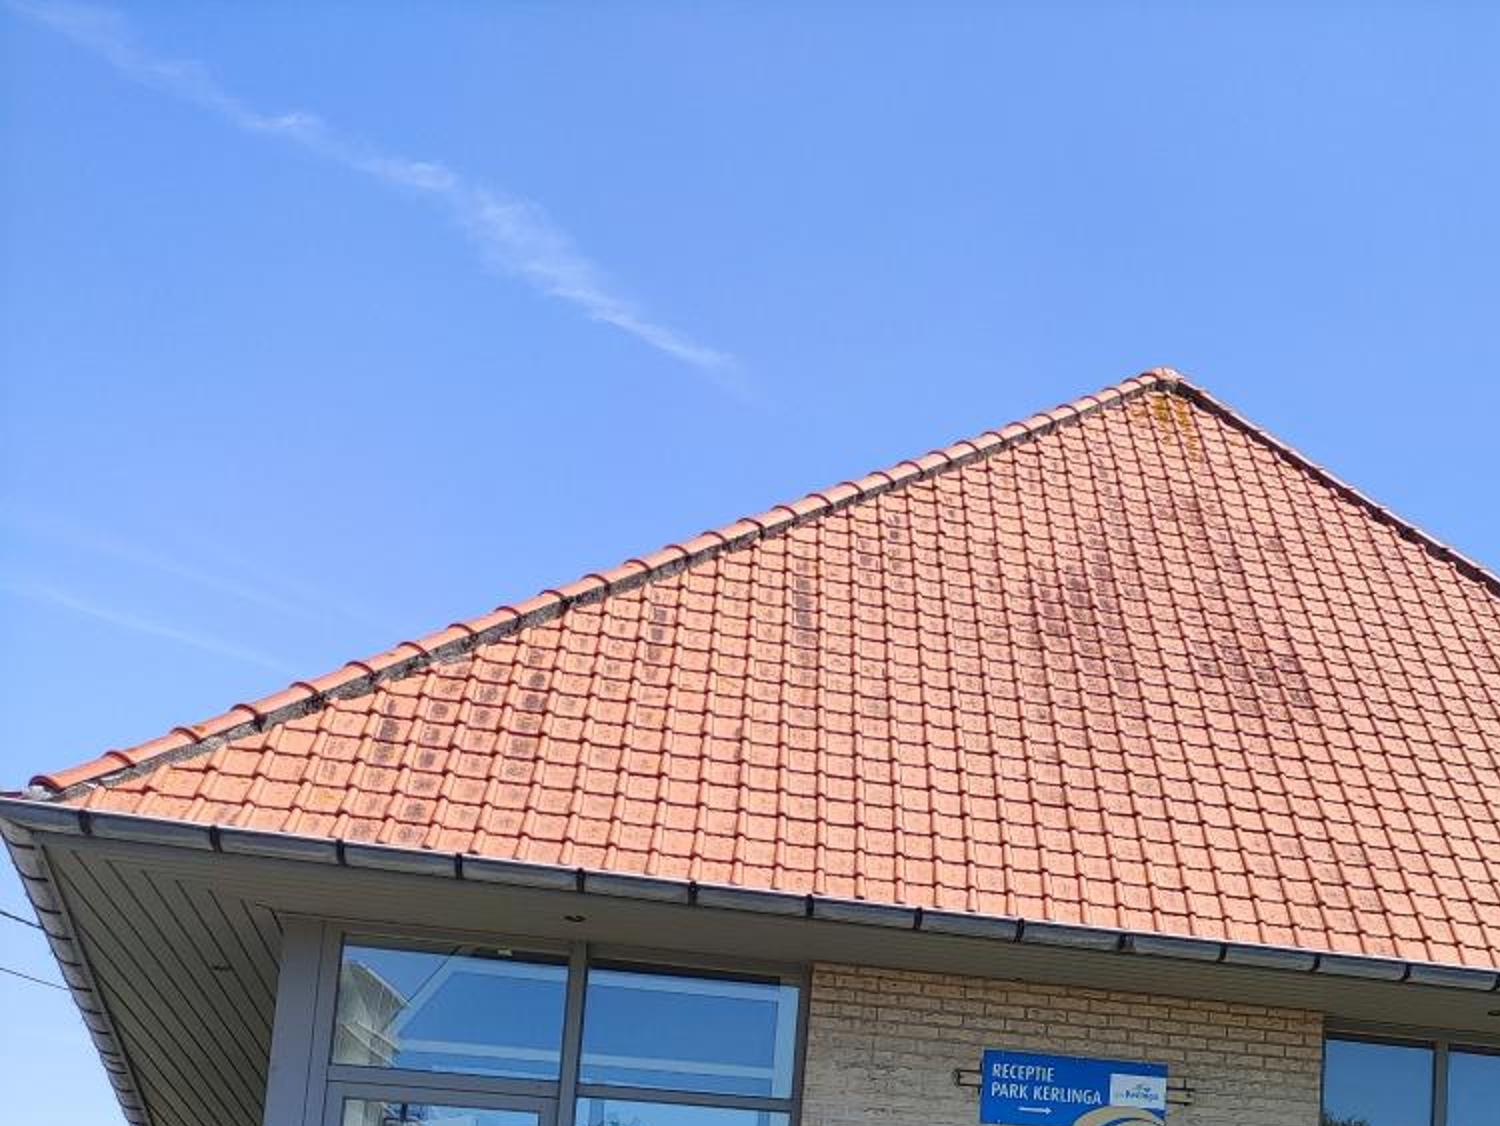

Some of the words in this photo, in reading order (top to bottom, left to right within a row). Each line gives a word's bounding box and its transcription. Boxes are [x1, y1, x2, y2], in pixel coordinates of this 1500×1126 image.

[991, 1063, 1055, 1083] RECEPTIE
[991, 1083, 1029, 1101] PARK
[1033, 1085, 1103, 1105] KERLINGA
